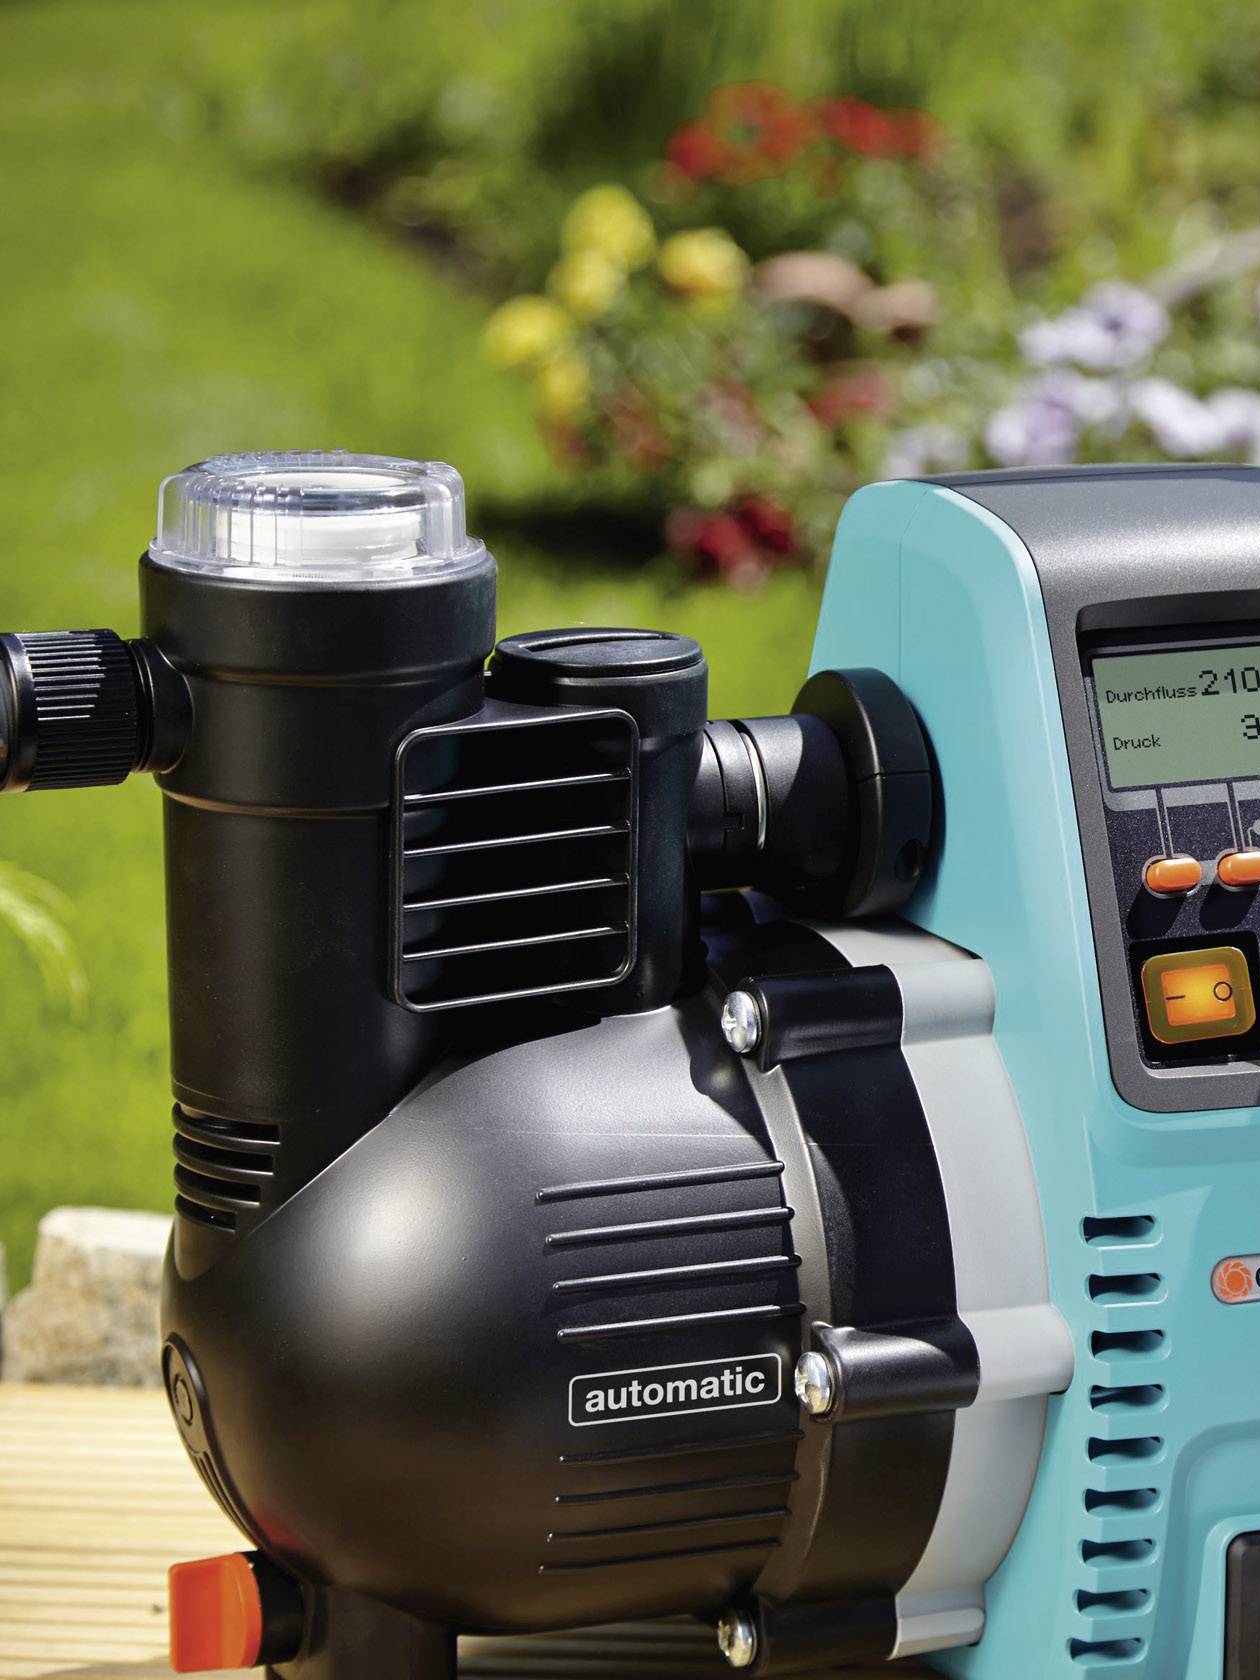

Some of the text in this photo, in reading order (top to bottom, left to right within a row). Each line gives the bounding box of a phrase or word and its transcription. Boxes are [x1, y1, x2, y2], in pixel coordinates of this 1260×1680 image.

[1105, 685, 1198, 704] Durchfluss
[1113, 734, 1161, 750] Druck
[585, 1366, 766, 1413] automatic
